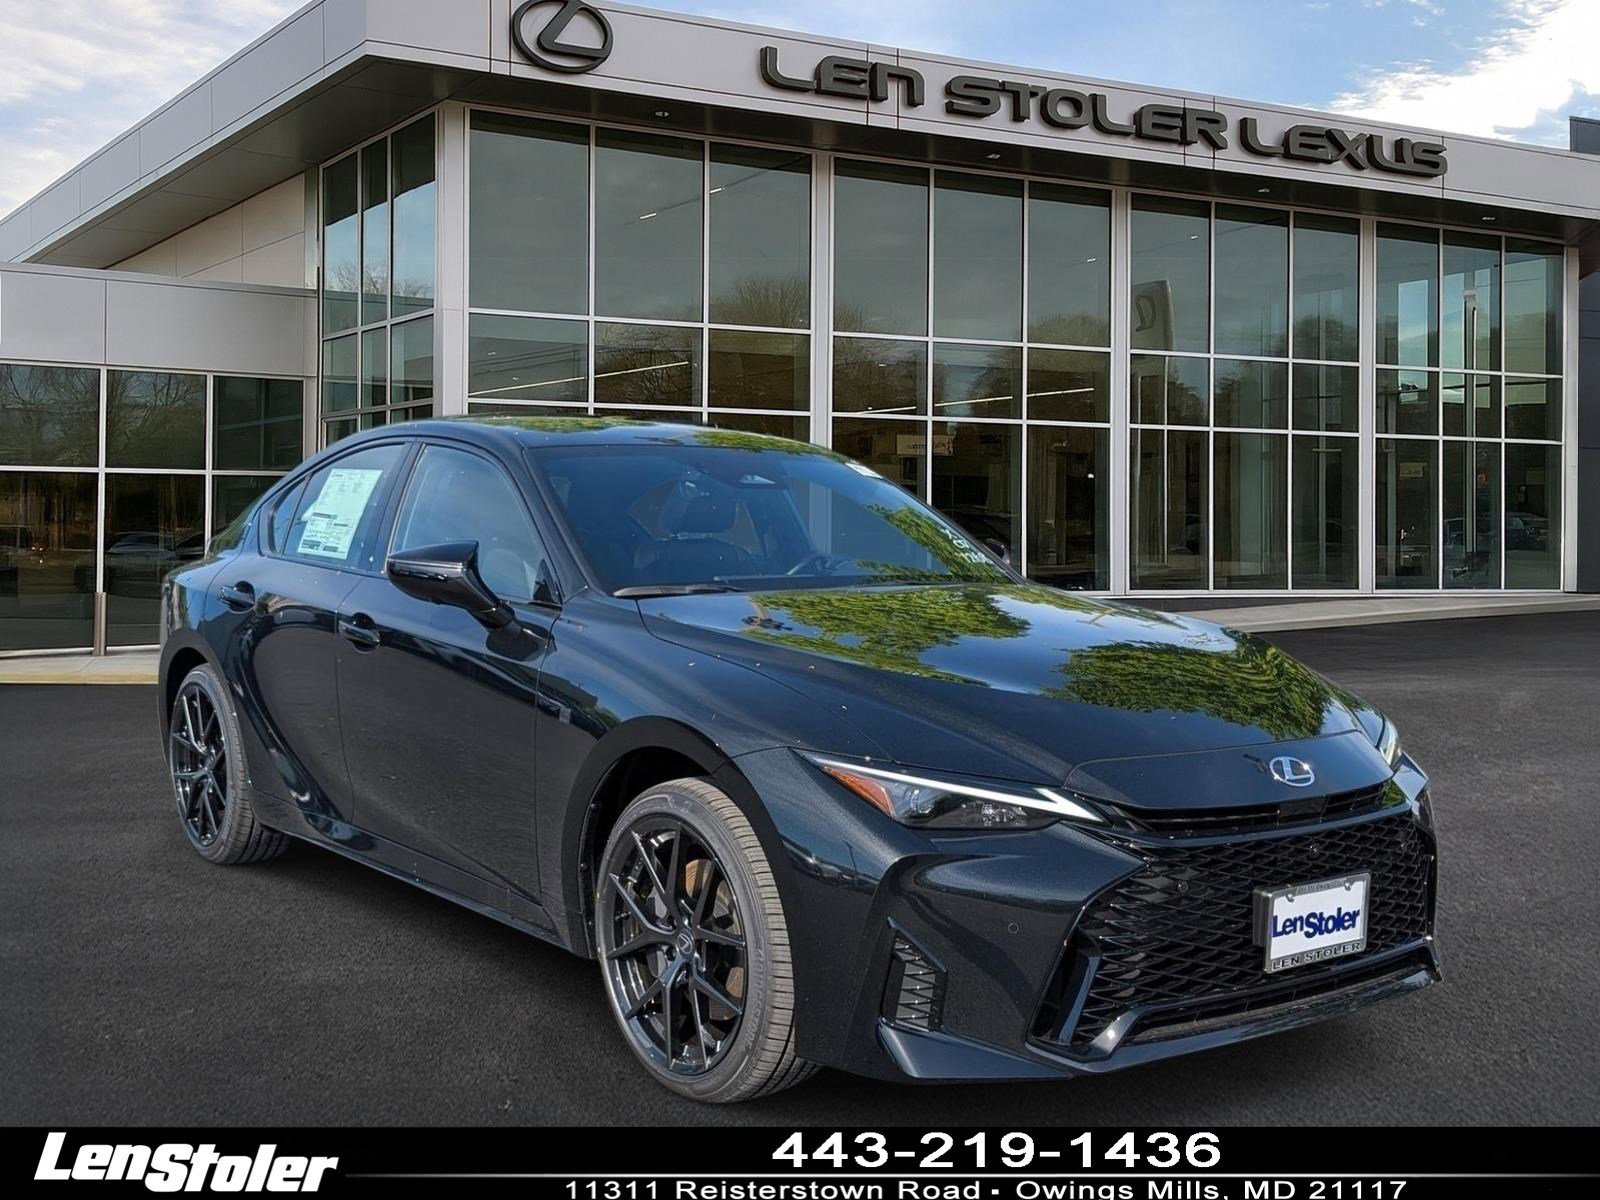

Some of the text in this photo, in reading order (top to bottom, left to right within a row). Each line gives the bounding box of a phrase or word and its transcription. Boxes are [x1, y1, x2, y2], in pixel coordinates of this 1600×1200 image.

[759, 46, 1448, 178] LEN STOLER LEXUS
[1270, 907, 1360, 938] LenStoler
[1272, 942, 1361, 970] LEN STOLER
